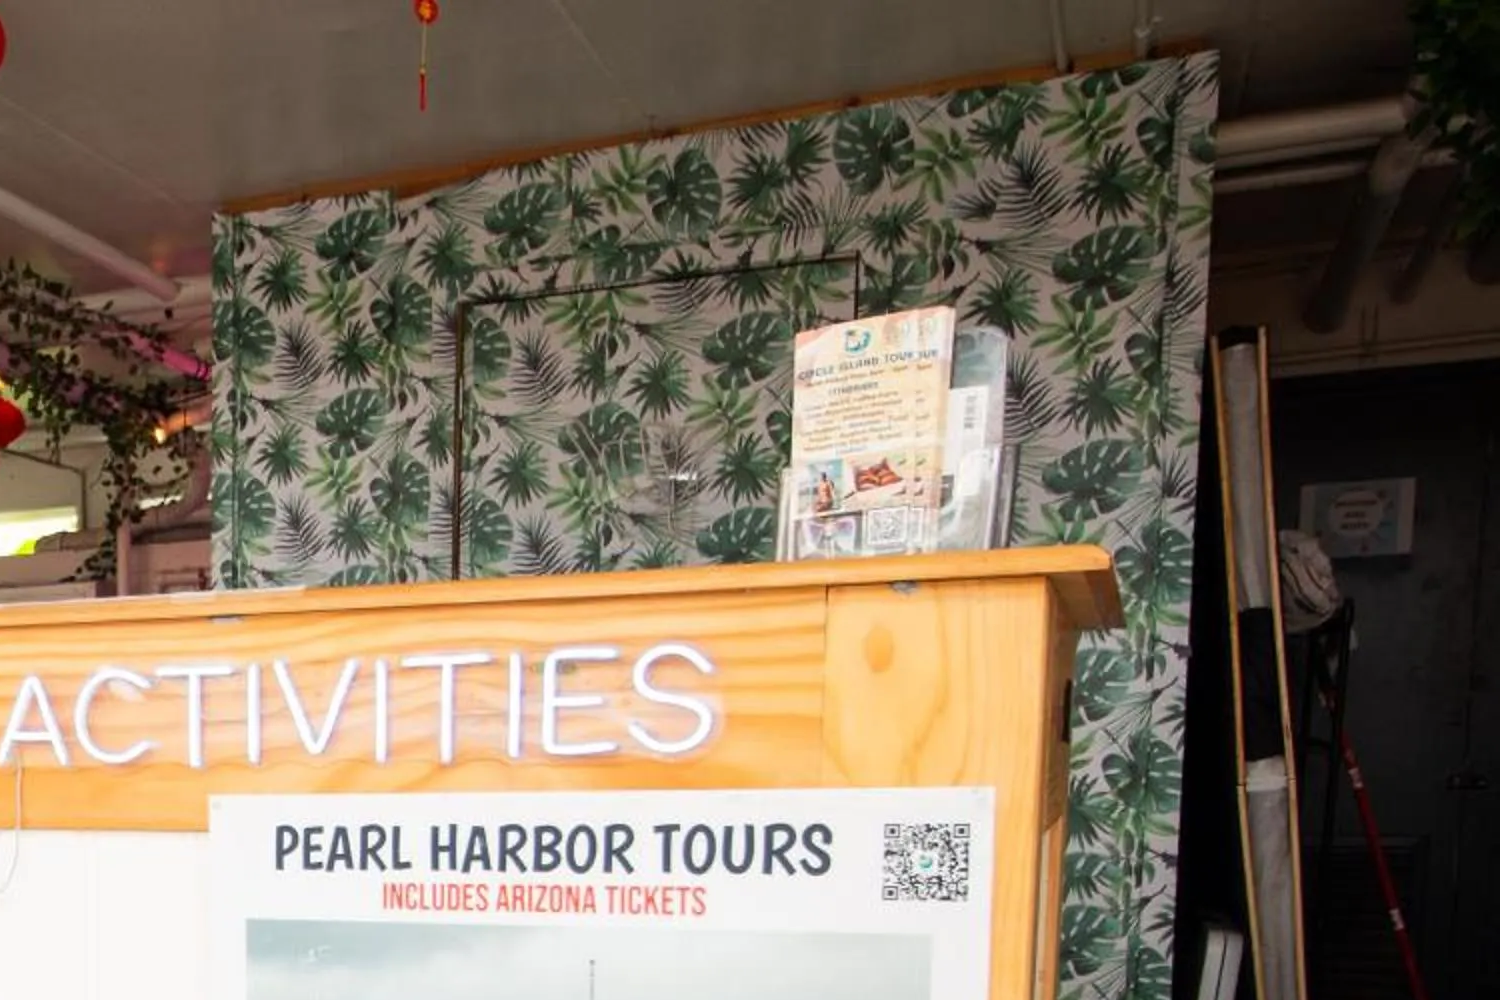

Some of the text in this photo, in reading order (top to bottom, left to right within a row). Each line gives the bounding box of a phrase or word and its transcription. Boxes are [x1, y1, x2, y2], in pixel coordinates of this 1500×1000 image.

[275, 821, 835, 877] PEARL HARBOR TOURS
[382, 882, 708, 917] INCLUDES ARIZONA TICKETS
